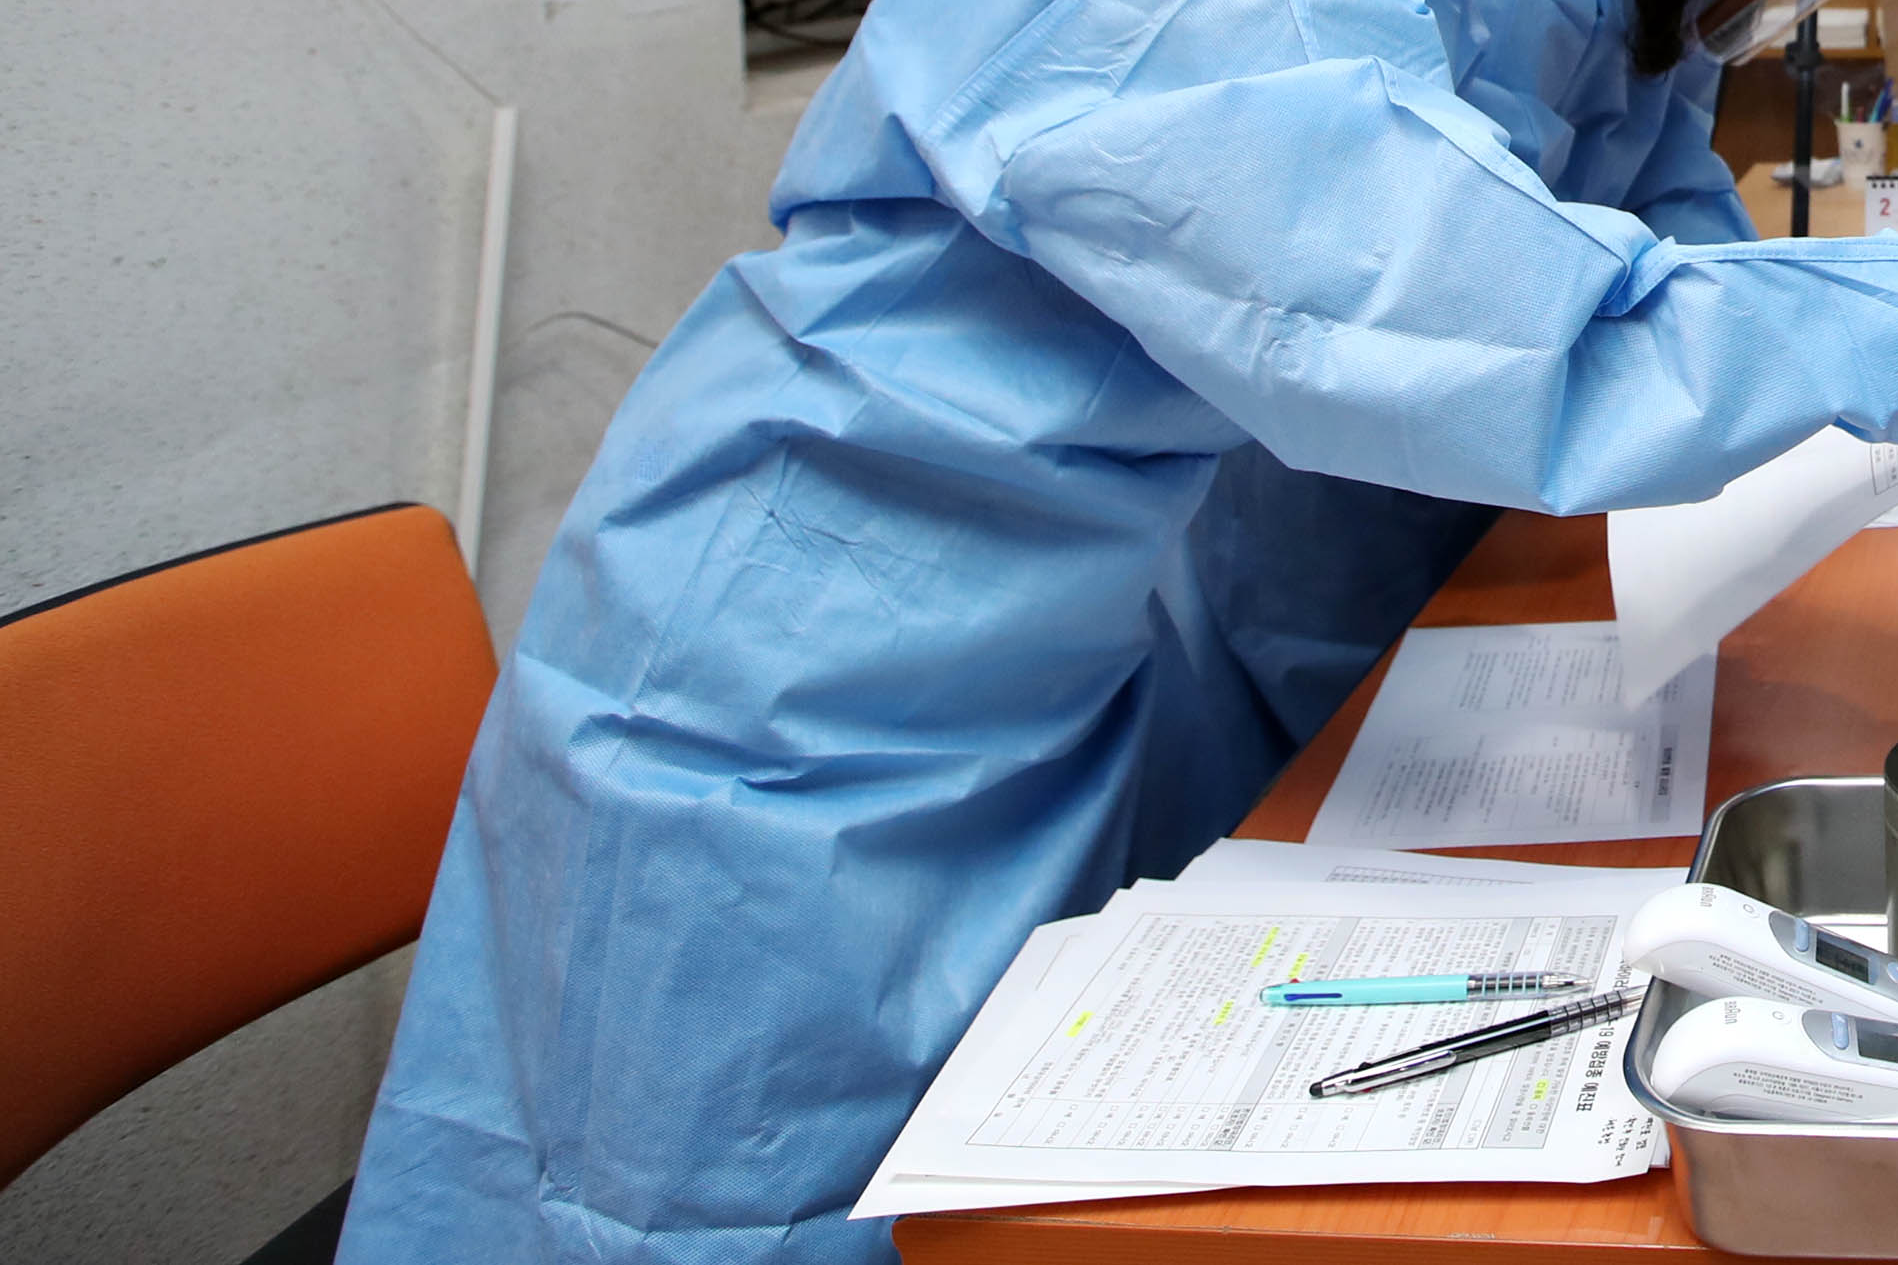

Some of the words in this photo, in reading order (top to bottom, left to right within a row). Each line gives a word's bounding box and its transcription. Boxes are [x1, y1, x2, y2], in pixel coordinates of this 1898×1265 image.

[1879, 197, 1892, 217] 2
[1585, 1039, 1612, 1078] 예방접종
[1576, 1081, 1599, 1113] 예진표
